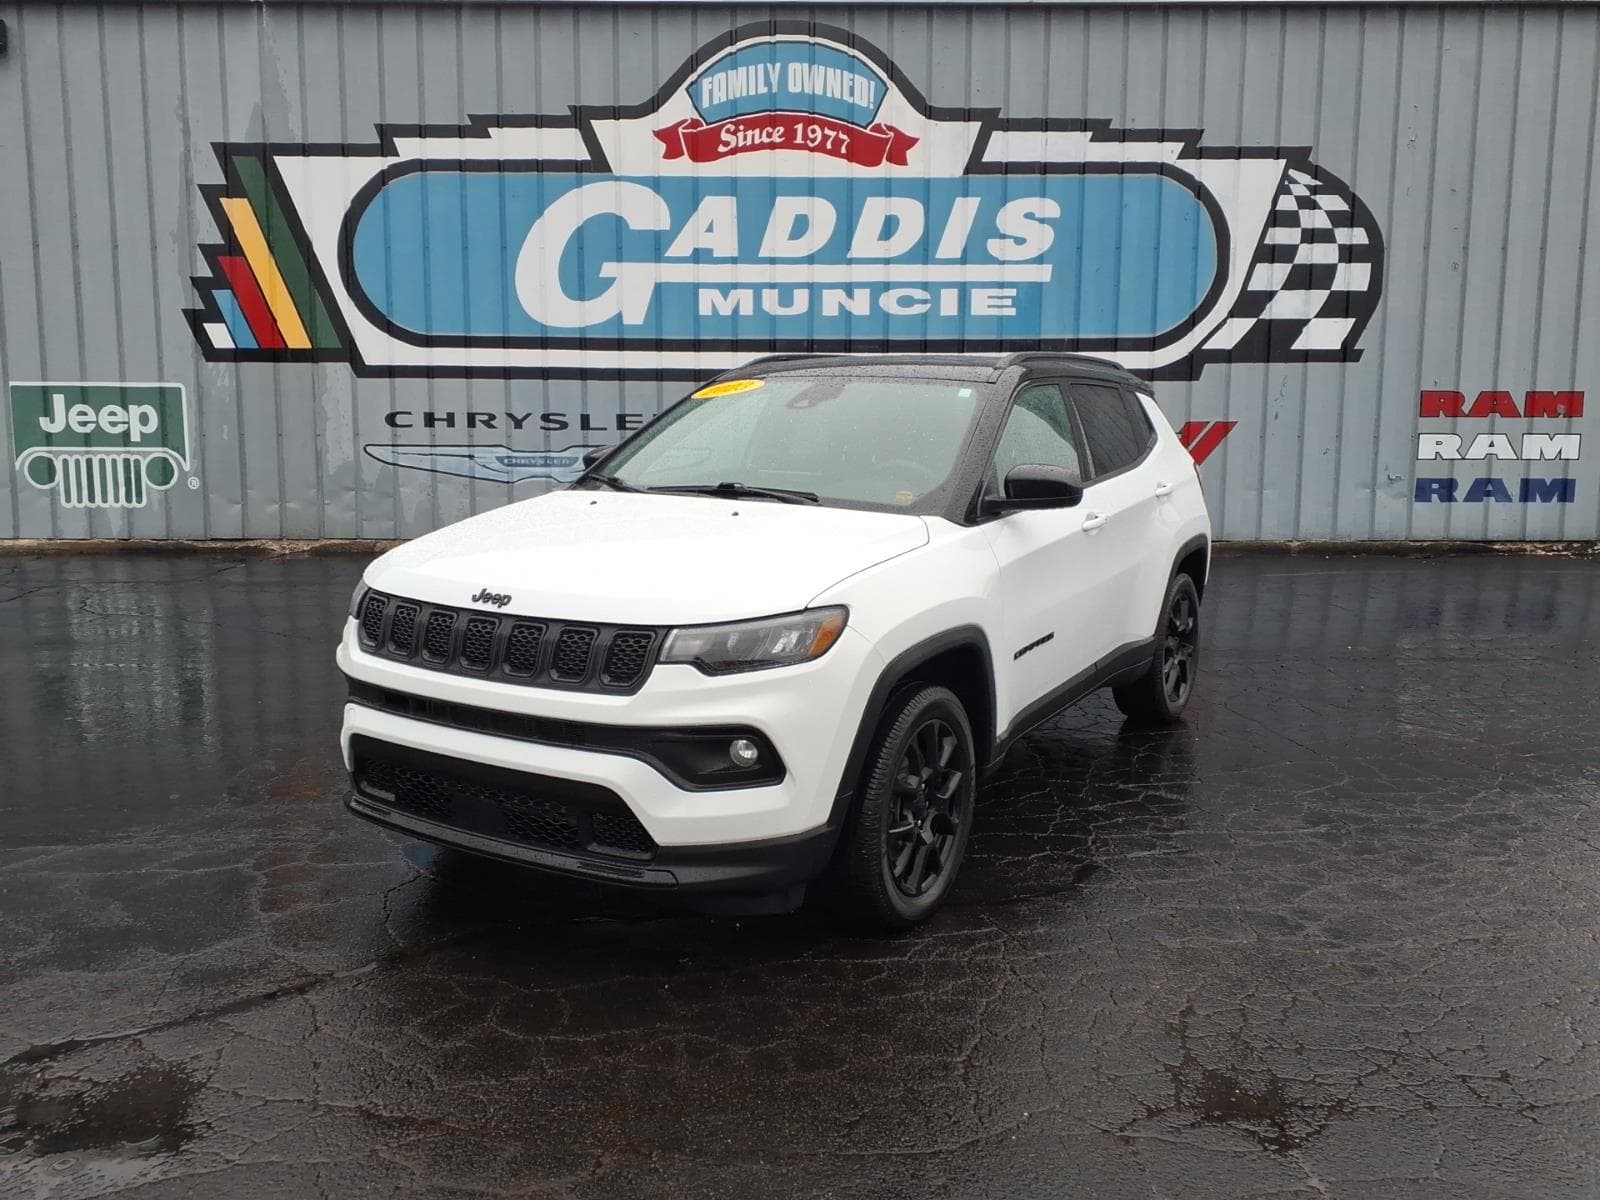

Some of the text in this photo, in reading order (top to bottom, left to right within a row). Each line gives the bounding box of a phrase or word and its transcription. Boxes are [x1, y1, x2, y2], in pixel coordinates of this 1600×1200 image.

[702, 62, 875, 109] FAMILY OWNED!
[717, 123, 850, 154] Since 1977
[515, 181, 1061, 327] GADDIS
[698, 288, 1017, 316] MUNCIE
[39, 394, 158, 442] Jeep
[1419, 390, 1584, 418] RAM
[384, 411, 658, 431] CHRYSLE
[1417, 433, 1582, 461] RAM
[1414, 477, 1577, 503] RAM
[471, 588, 512, 608] Jeep
